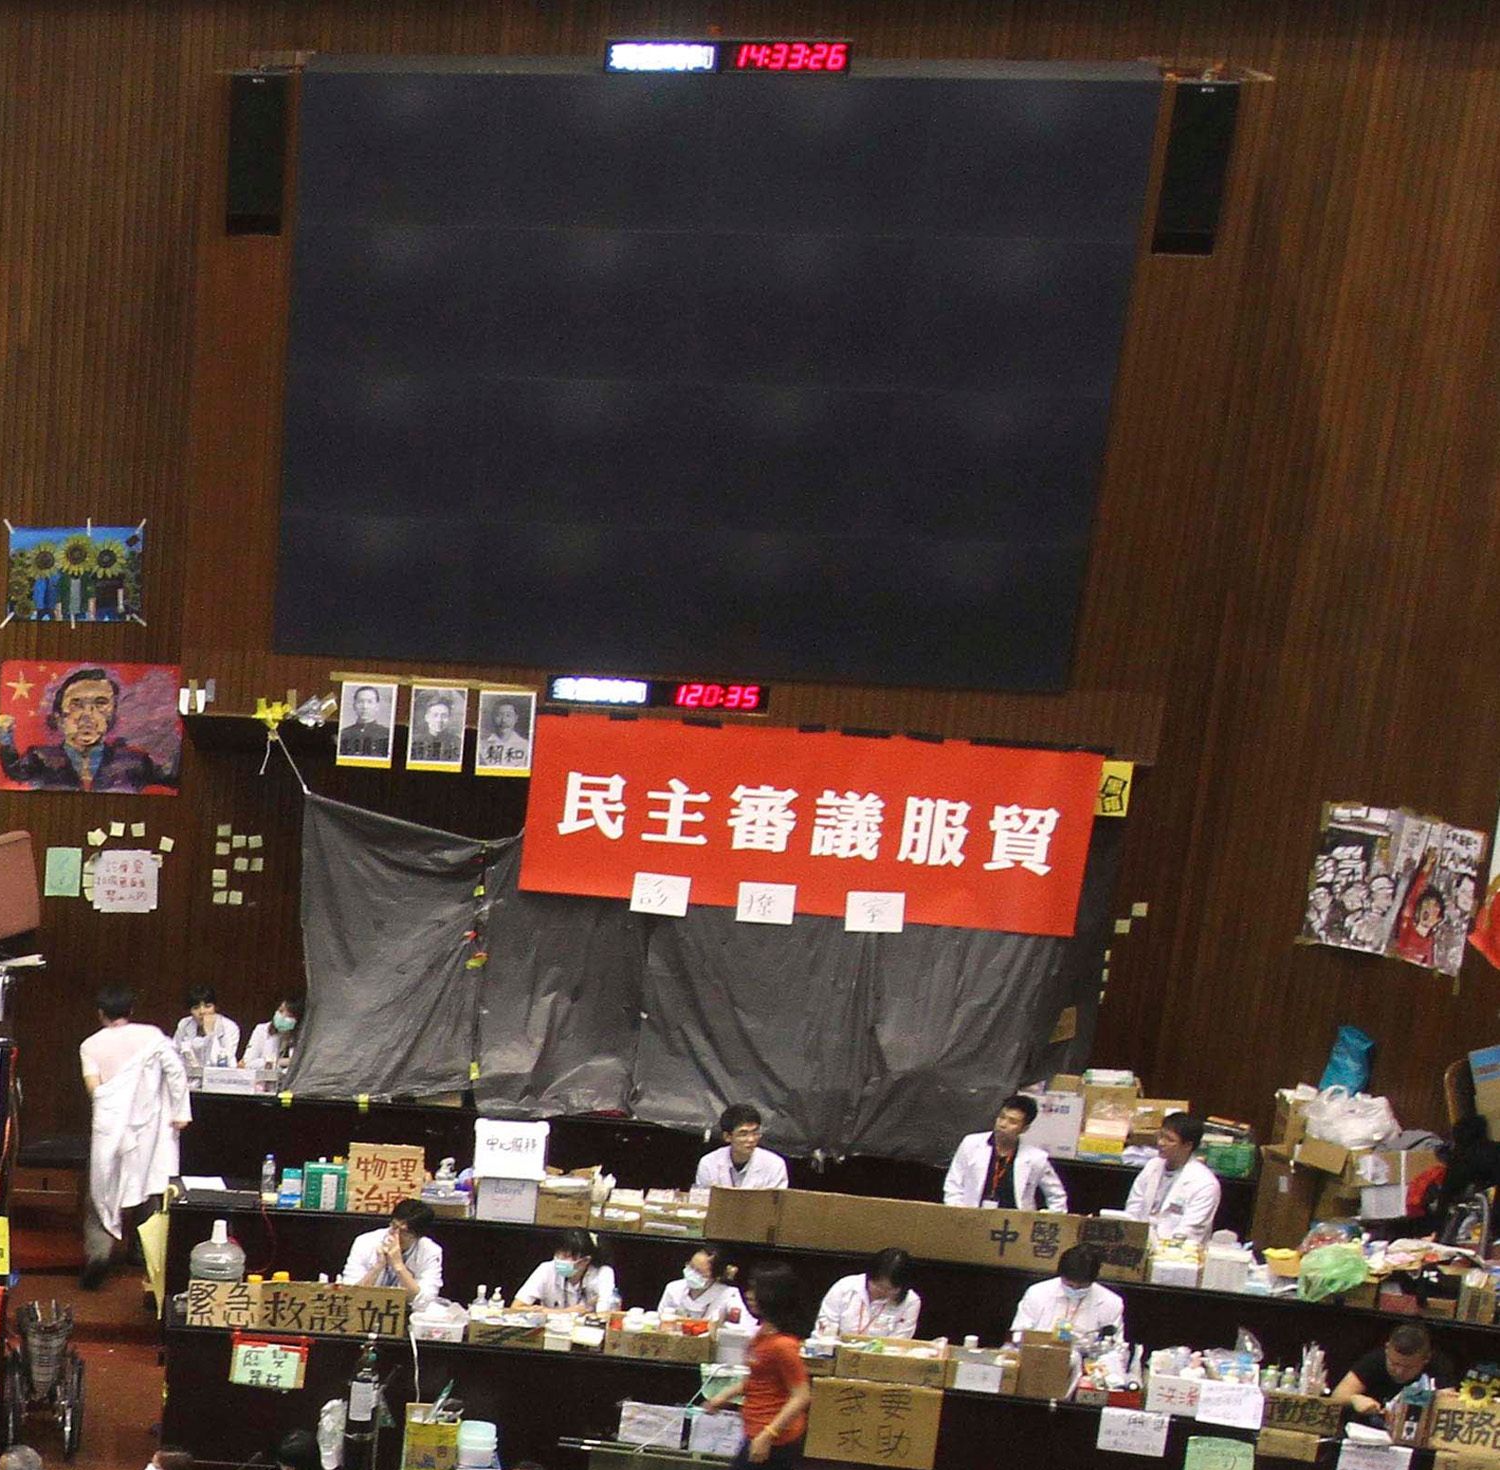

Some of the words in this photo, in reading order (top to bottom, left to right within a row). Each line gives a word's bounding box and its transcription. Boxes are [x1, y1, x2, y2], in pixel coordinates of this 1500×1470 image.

[737, 43, 847, 71] 14:33:26
[674, 682, 761, 711] 120:35
[557, 771, 1061, 876] 民主審議服貿
[355, 1155, 417, 1181] 物理
[187, 1280, 405, 1337] 緊急救護站
